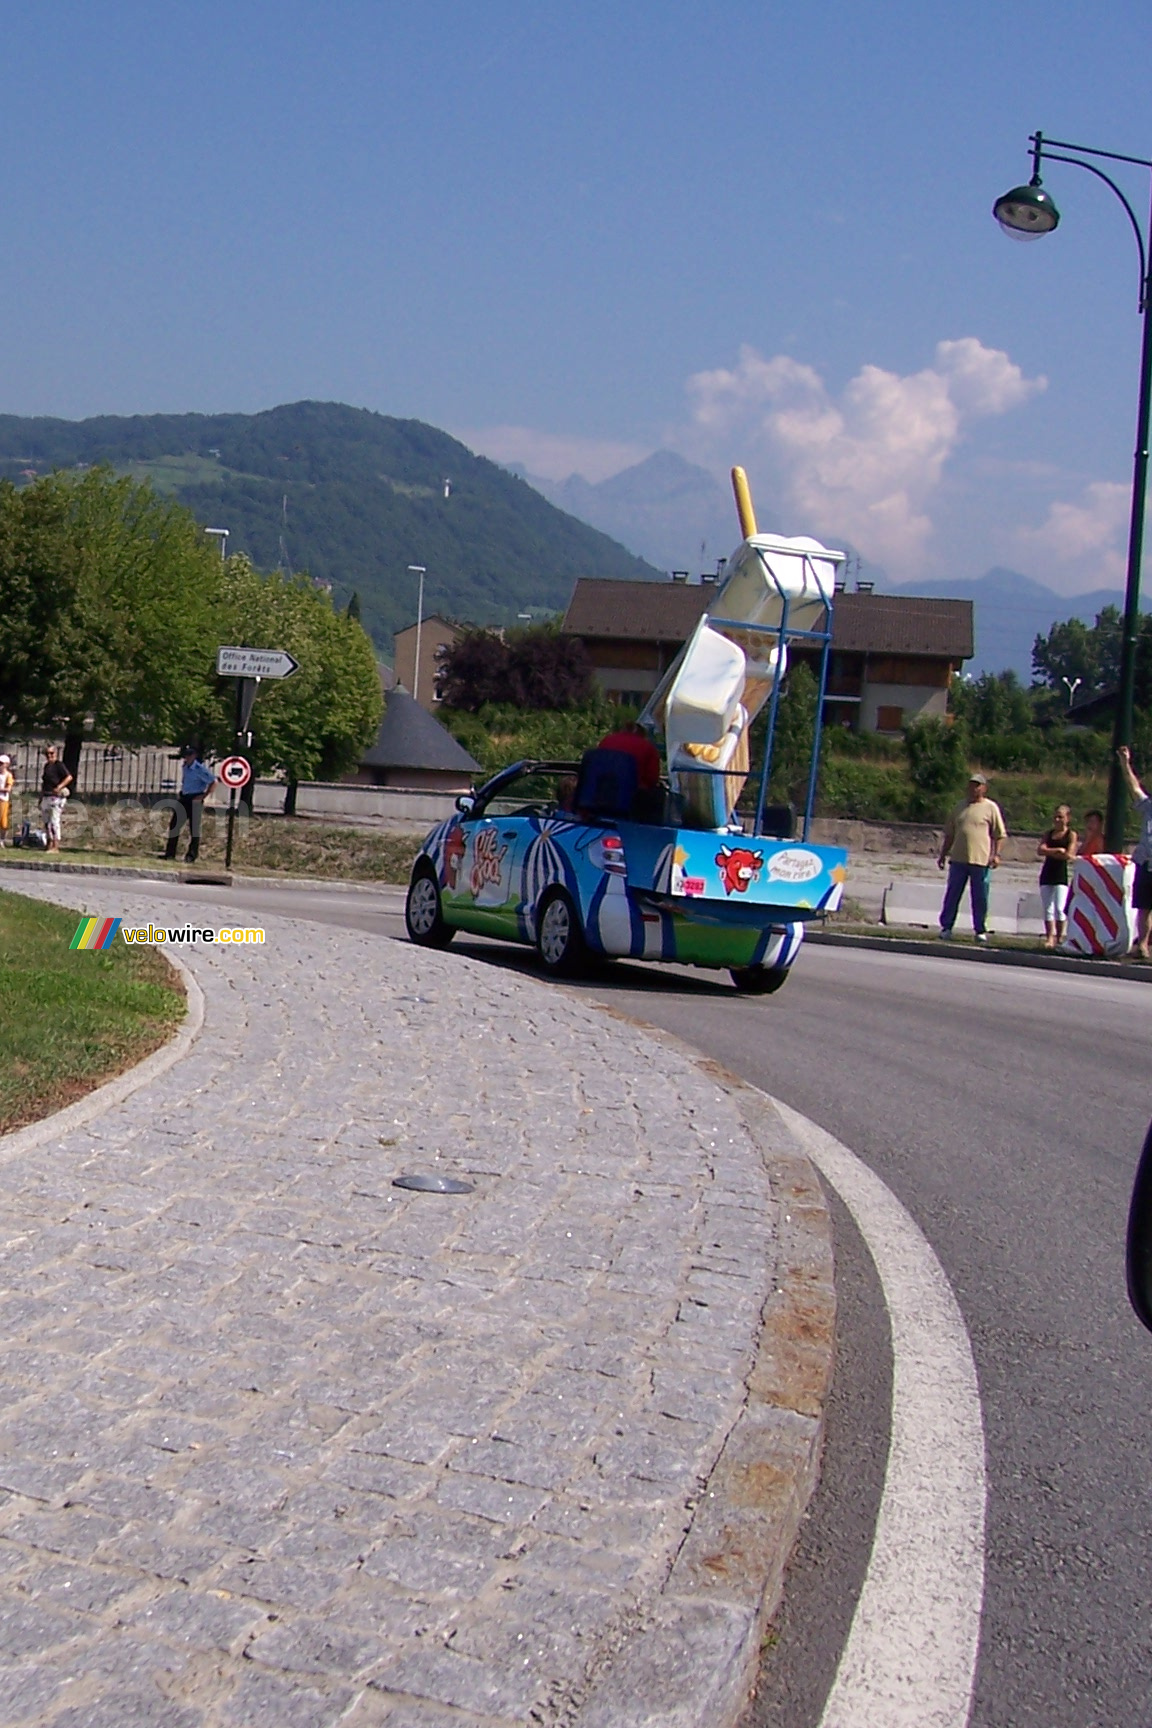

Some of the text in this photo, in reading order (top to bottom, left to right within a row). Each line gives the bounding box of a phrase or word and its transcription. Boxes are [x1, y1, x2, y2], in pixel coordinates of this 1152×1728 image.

[222, 652, 283, 664] Office National
[222, 663, 270, 673] des Forêts
